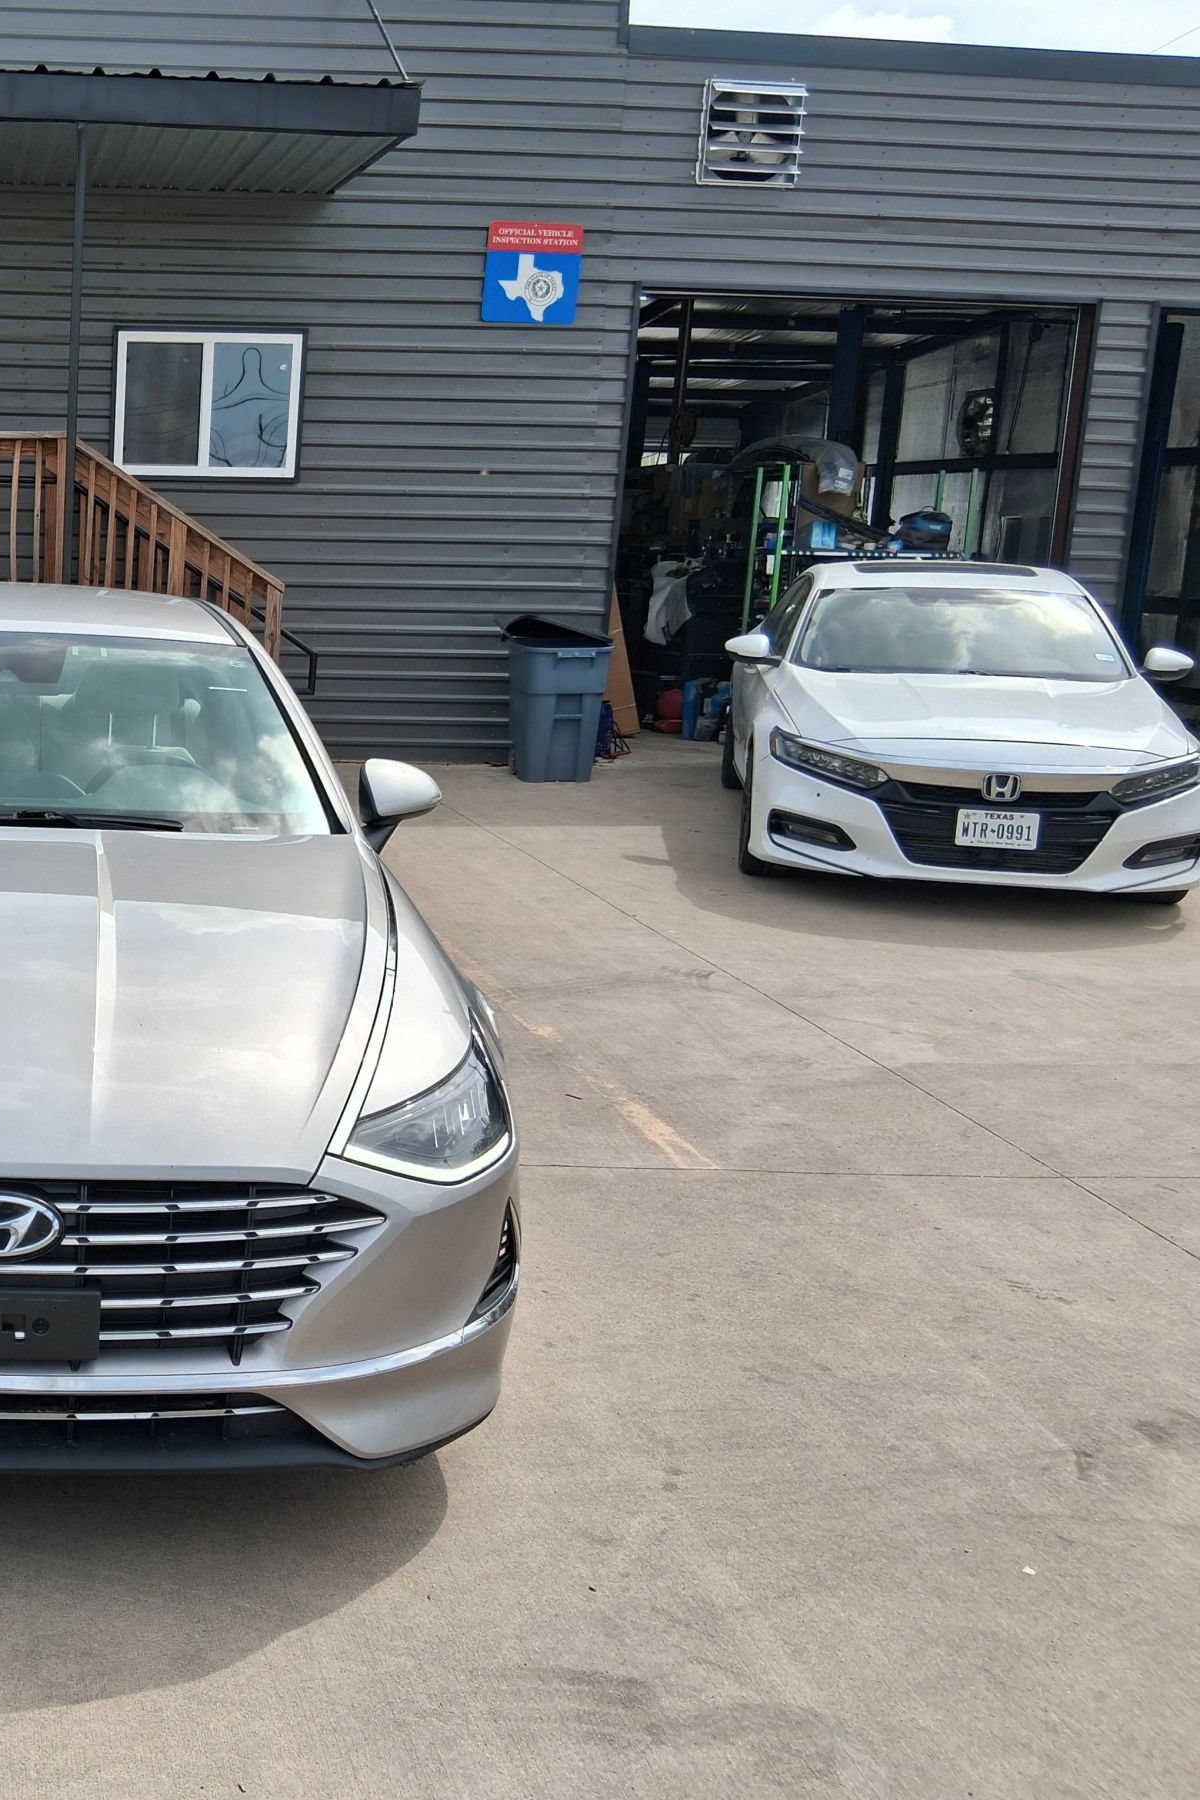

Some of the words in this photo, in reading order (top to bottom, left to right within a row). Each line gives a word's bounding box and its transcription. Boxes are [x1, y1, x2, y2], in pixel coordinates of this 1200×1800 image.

[498, 227, 537, 236] OFFICIAL
[538, 229, 574, 238] VEHICLE
[492, 236, 541, 245] INSPECTION
[543, 238, 579, 246] STATION
[984, 812, 1015, 821] TEXAS
